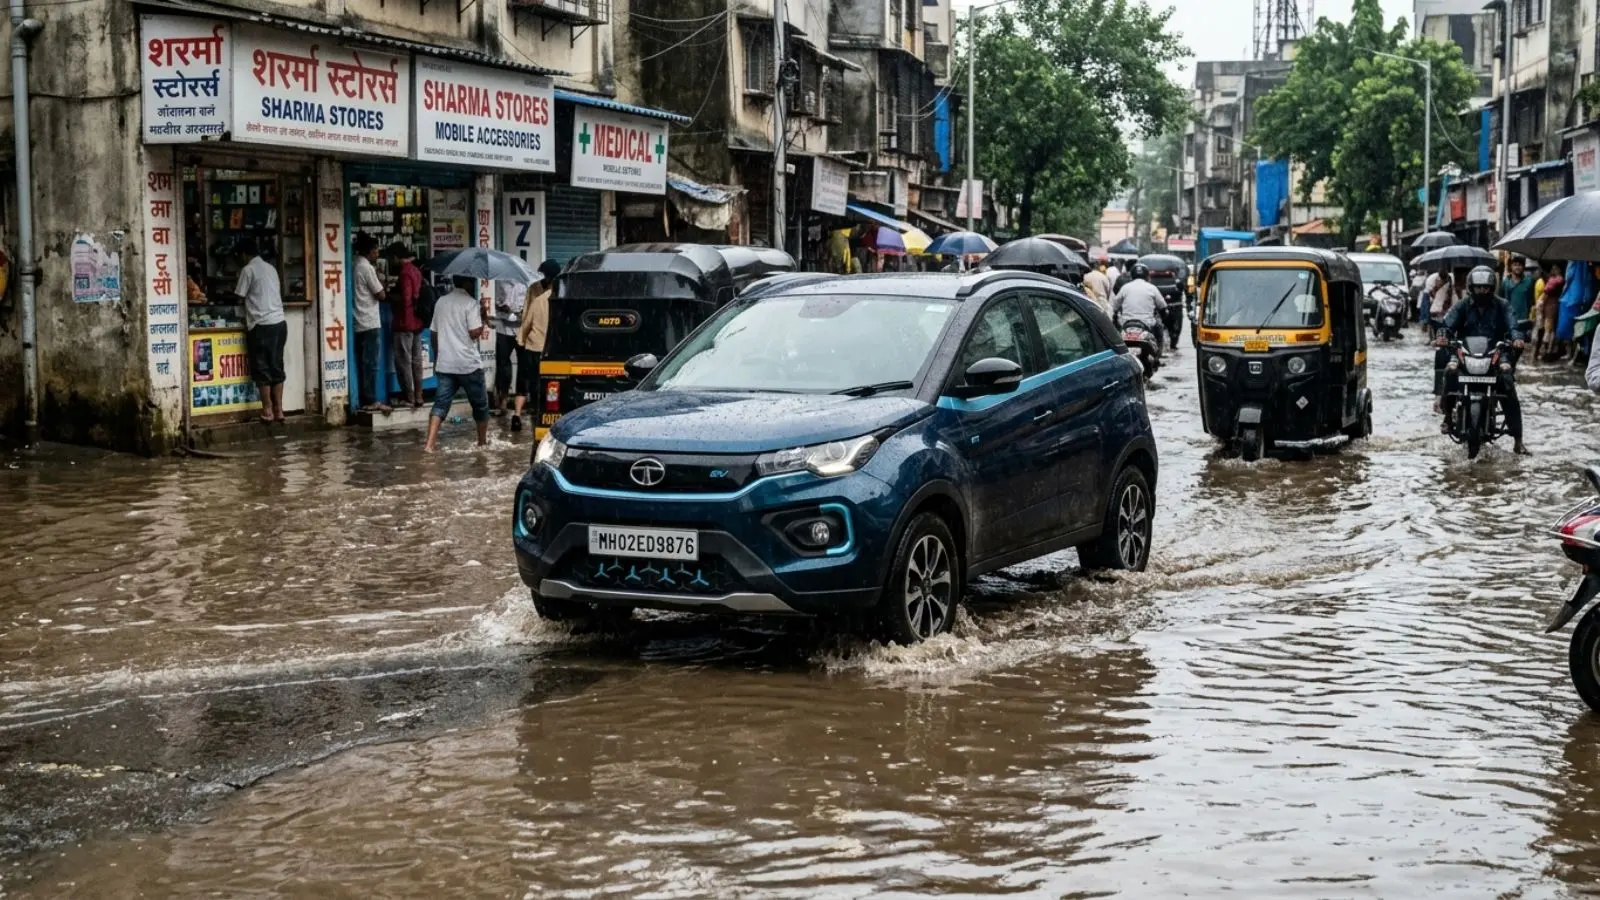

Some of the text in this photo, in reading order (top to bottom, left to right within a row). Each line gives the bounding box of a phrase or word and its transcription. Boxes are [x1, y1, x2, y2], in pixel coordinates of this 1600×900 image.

[261, 96, 384, 131] SHARMA STORES
[424, 79, 549, 126] SHARMA STORES
[435, 121, 541, 151] MOBILE ACCESSORIES
[593, 123, 652, 163] MEDICAL
[599, 532, 695, 554] MH02ED9876
